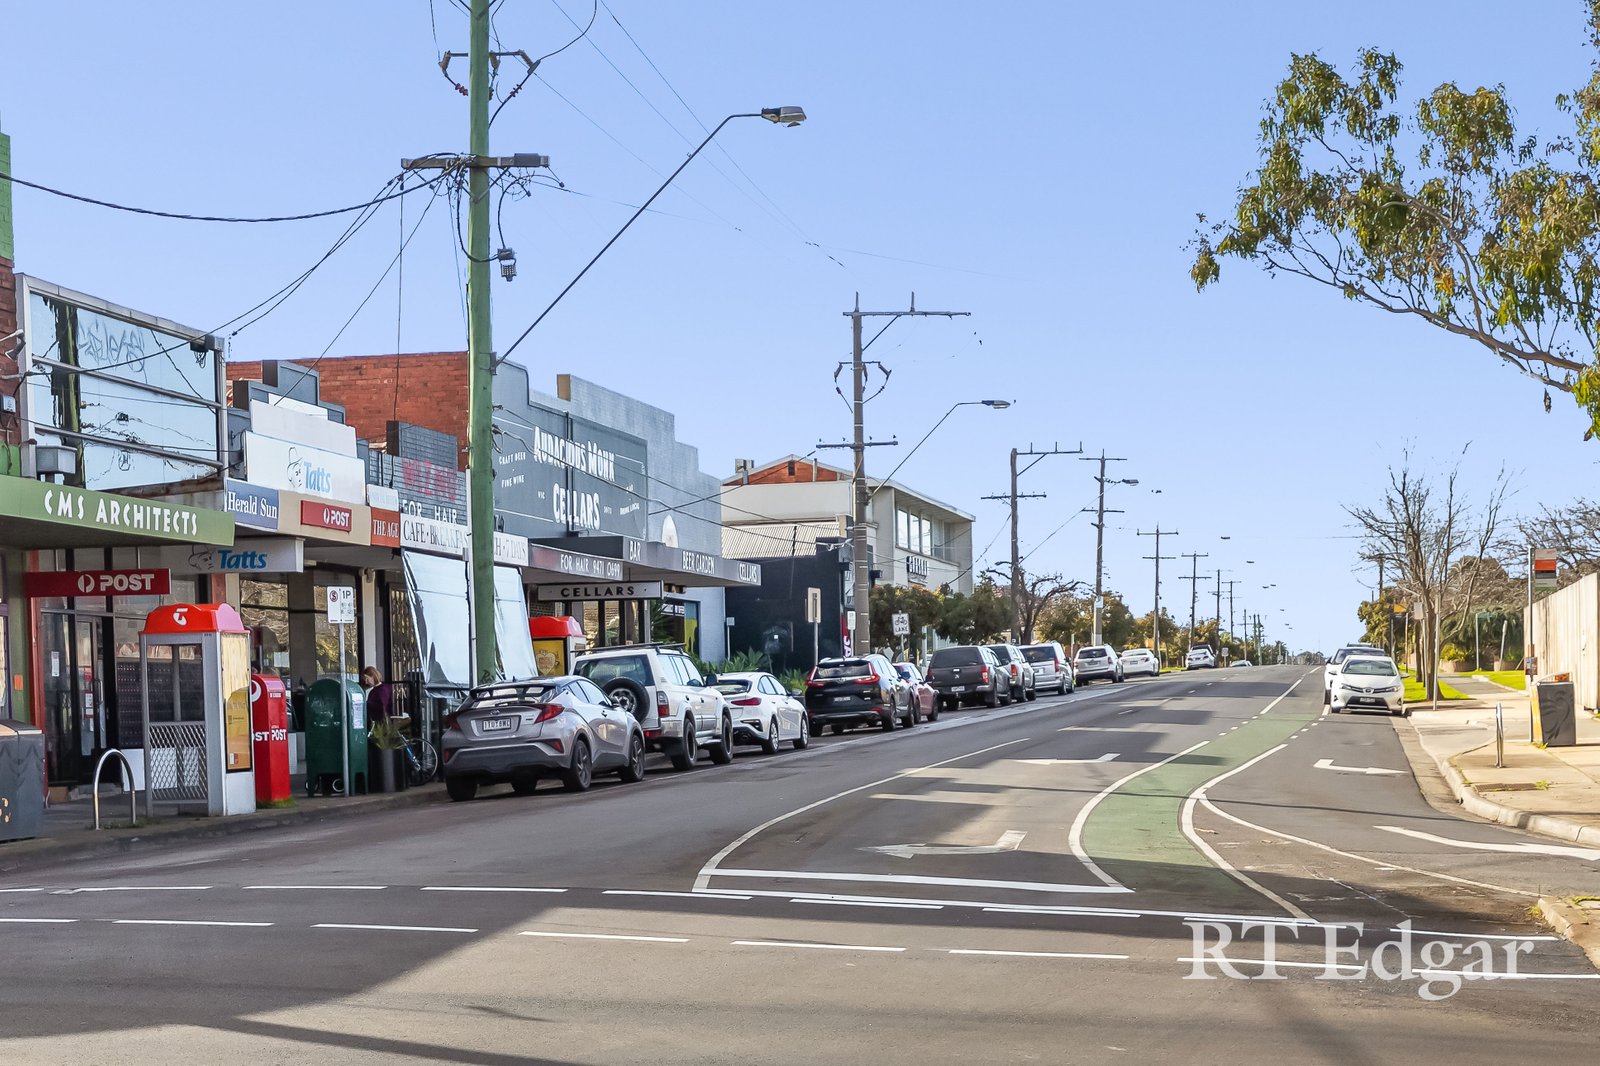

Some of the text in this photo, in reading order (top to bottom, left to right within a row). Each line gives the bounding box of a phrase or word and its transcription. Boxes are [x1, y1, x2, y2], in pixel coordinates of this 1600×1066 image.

[534, 426, 587, 475] AUDACIOUS
[304, 461, 332, 494] Tatts
[44, 489, 198, 537] CMS ARCHITECTS
[227, 491, 279, 520] Herald Sun
[402, 499, 422, 517] FOR
[434, 505, 458, 524] HAIR
[553, 482, 600, 531] CELLARS
[330, 510, 350, 528] POST
[373, 519, 399, 538] THE AGE
[403, 519, 426, 543] CAFE
[217, 549, 267, 570] Tatts
[629, 540, 641, 562] BAR
[560, 554, 573, 571] FOR
[575, 557, 590, 573] HAIR
[682, 550, 716, 575] BEER GARDEN
[739, 562, 758, 583] CELLARS
[100, 574, 155, 592] POST
[560, 584, 636, 599] CELLARS
[342, 590, 352, 600] 1P
[271, 728, 288, 742] POST
